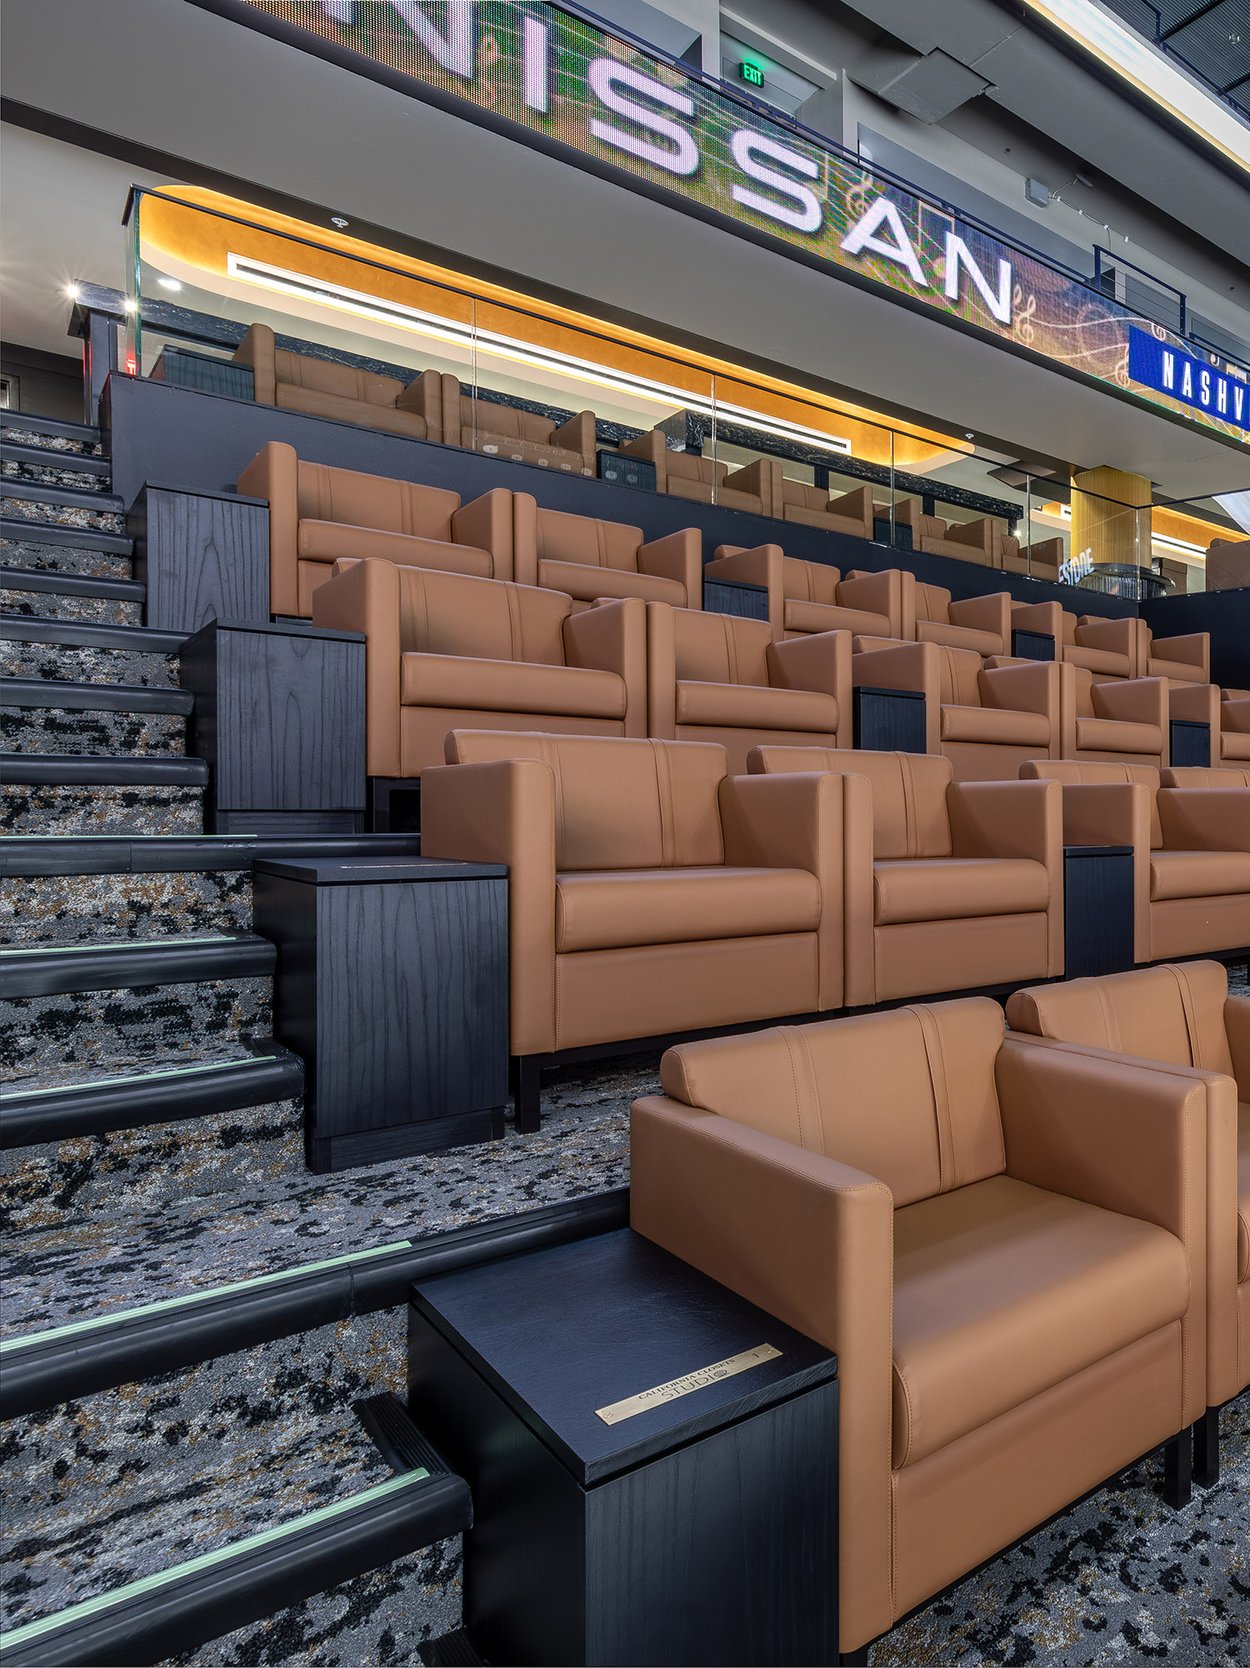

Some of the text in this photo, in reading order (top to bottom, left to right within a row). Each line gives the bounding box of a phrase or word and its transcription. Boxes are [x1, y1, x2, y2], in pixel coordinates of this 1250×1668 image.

[744, 64, 762, 86] EXIT
[638, 1358, 736, 1400] CALIFORNIA CLOSETS
[661, 1369, 729, 1400] STUDIO
